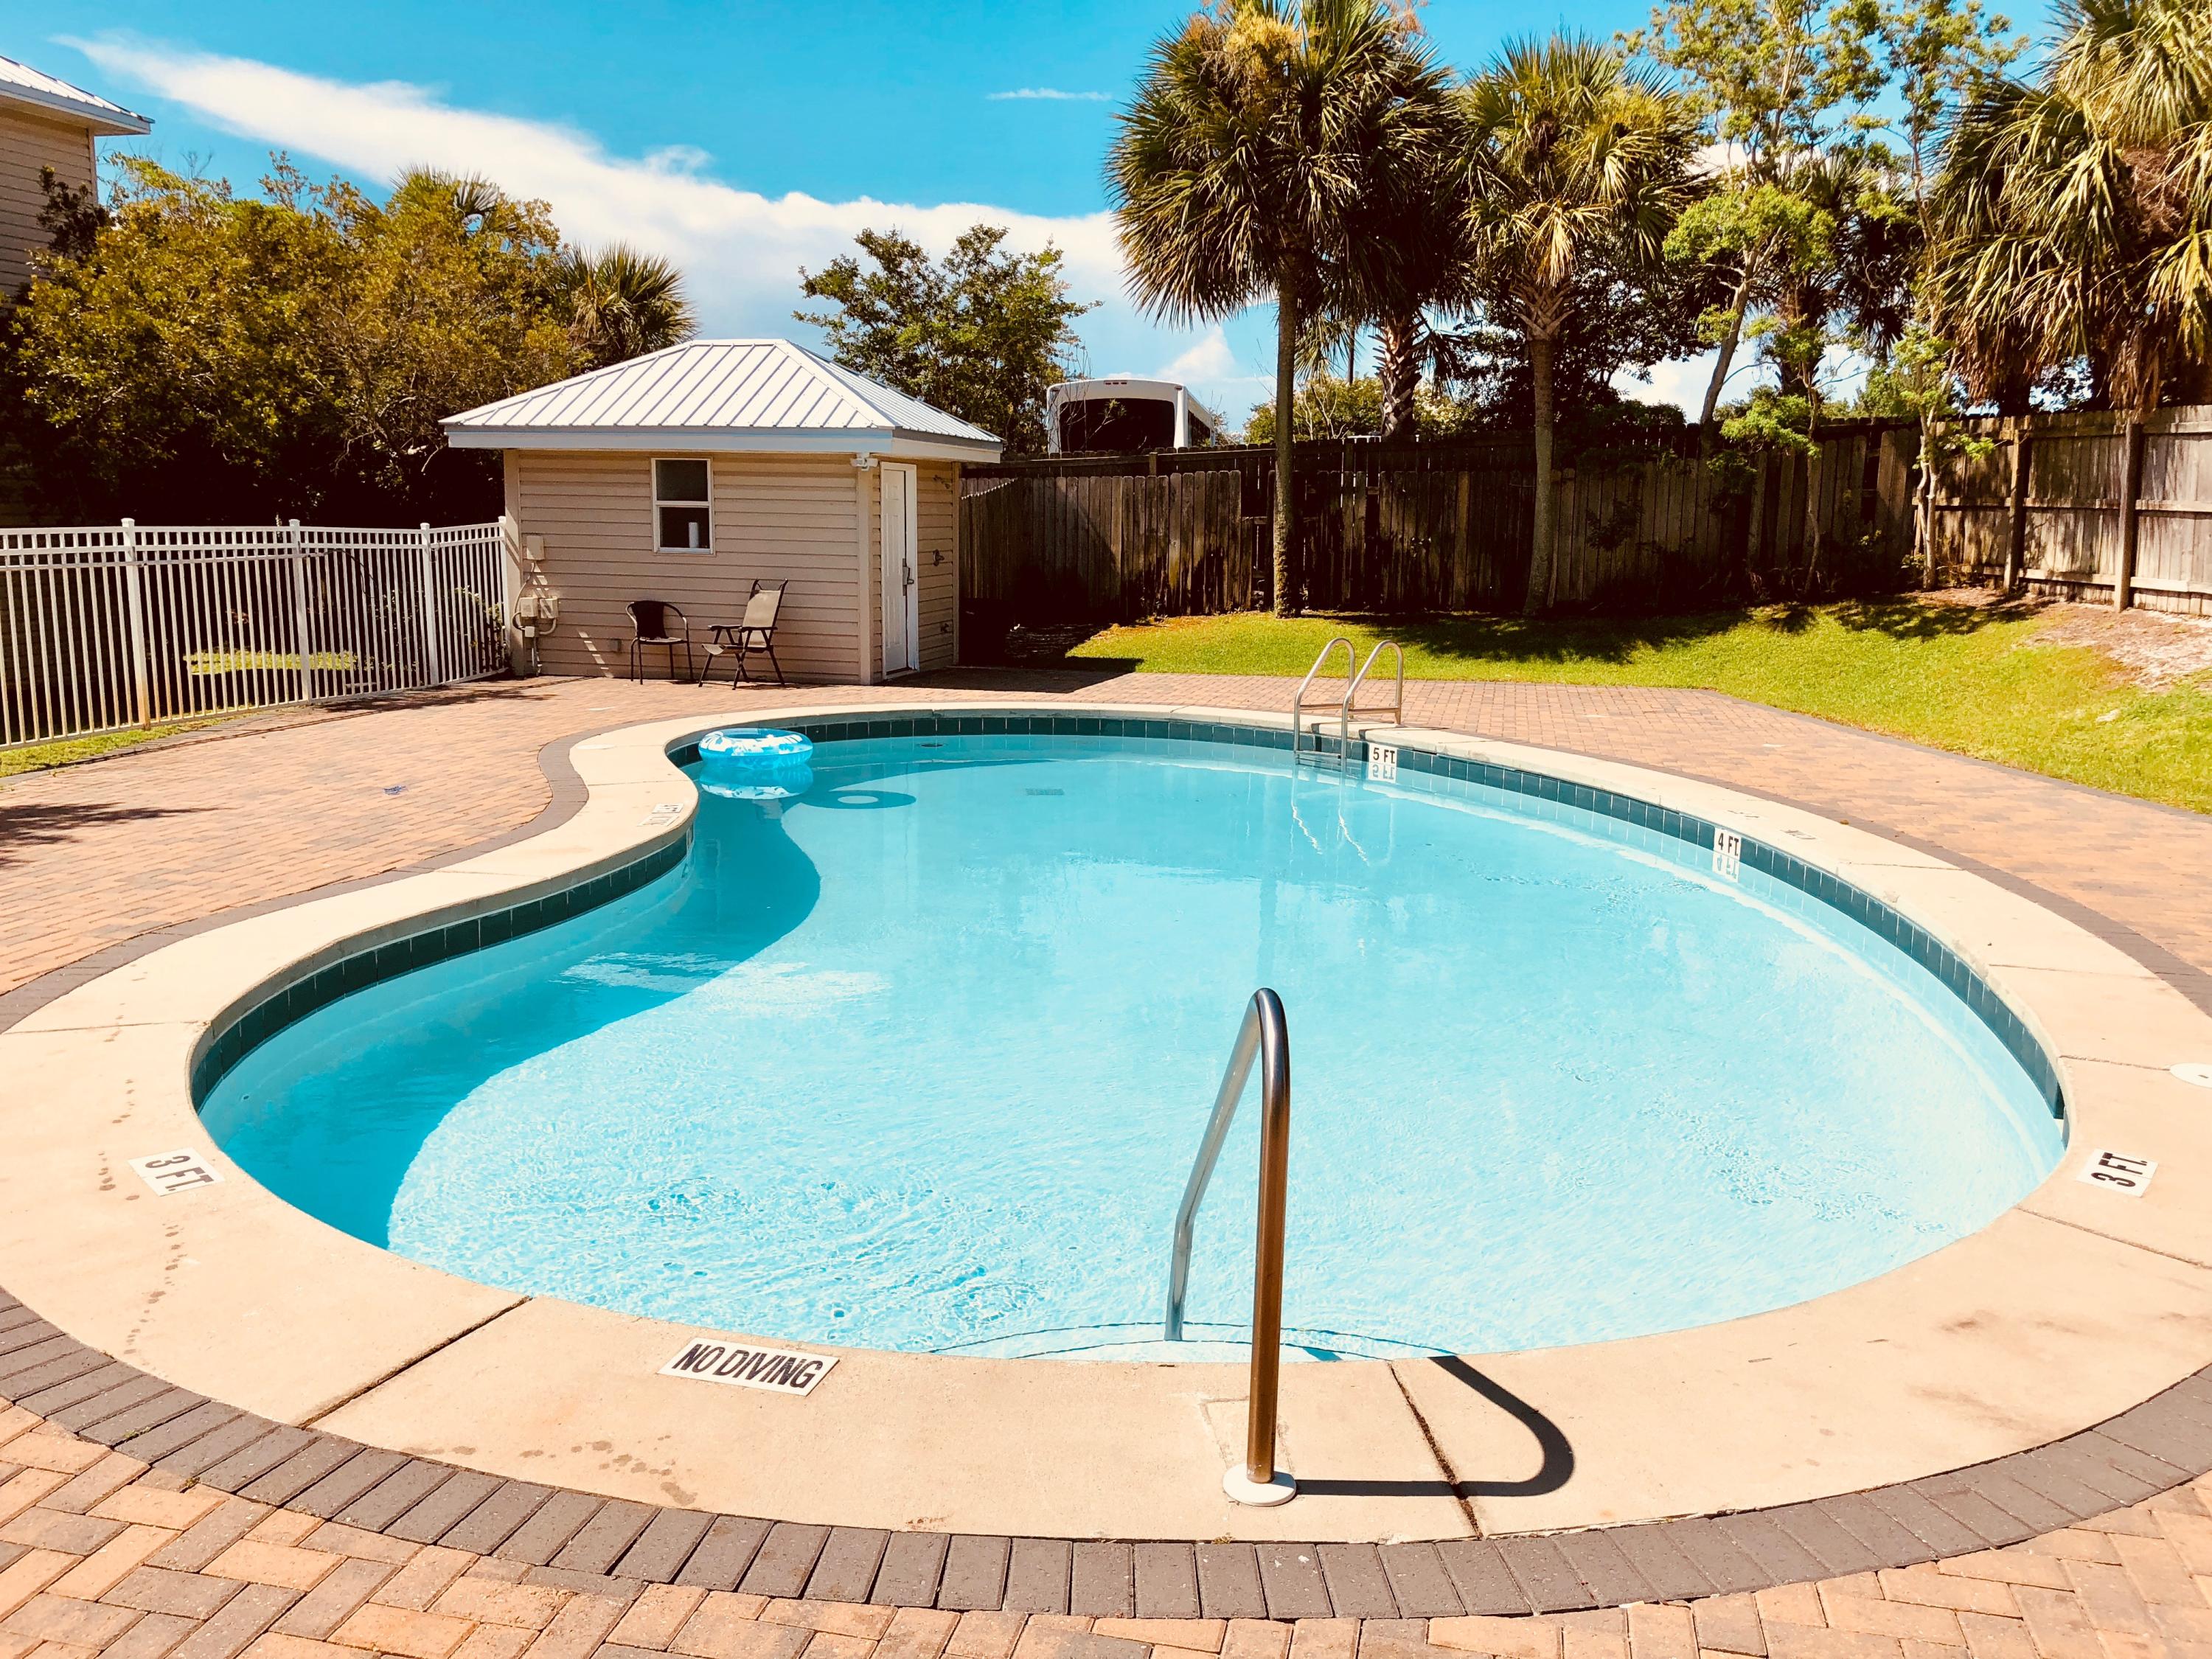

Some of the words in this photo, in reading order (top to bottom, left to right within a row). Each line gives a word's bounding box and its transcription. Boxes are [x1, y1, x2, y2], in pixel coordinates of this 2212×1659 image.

[1373, 747, 1380, 760] 5
[1383, 748, 1395, 764] FT.
[1718, 832, 1724, 850] 4
[1728, 835, 1739, 857] FT.
[145, 1155, 191, 1169] 3
[2098, 1152, 2147, 1175] FT.
[155, 1166, 215, 1192] FT.
[2090, 1172, 2136, 1187] 3
[671, 1343, 726, 1373] NO
[712, 1349, 824, 1388] DIVING
